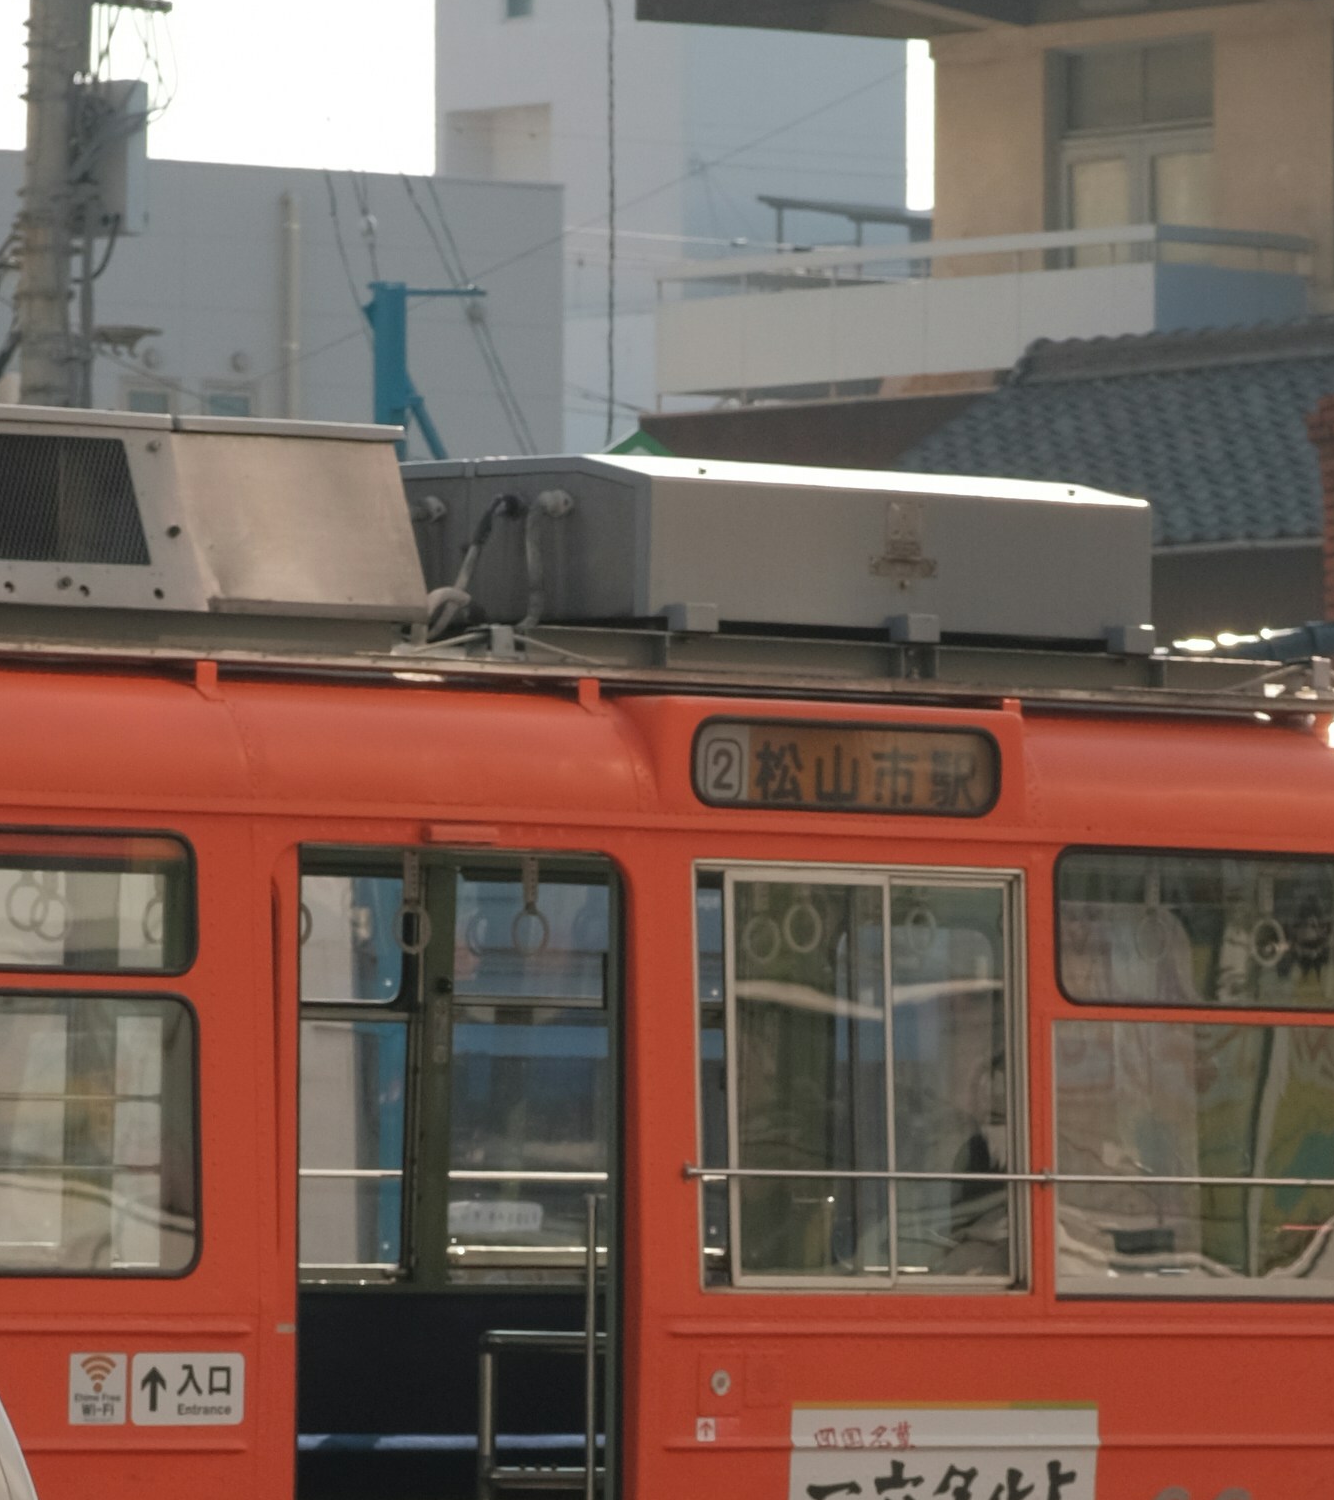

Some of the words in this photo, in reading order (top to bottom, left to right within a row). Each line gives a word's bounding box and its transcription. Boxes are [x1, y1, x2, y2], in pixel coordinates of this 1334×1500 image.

[712, 747, 734, 792] 2
[755, 740, 977, 808] 松山市駅
[177, 1364, 232, 1396] 入口
[82, 1403, 114, 1416] Wi-Fi
[177, 1403, 232, 1416] Entrance
